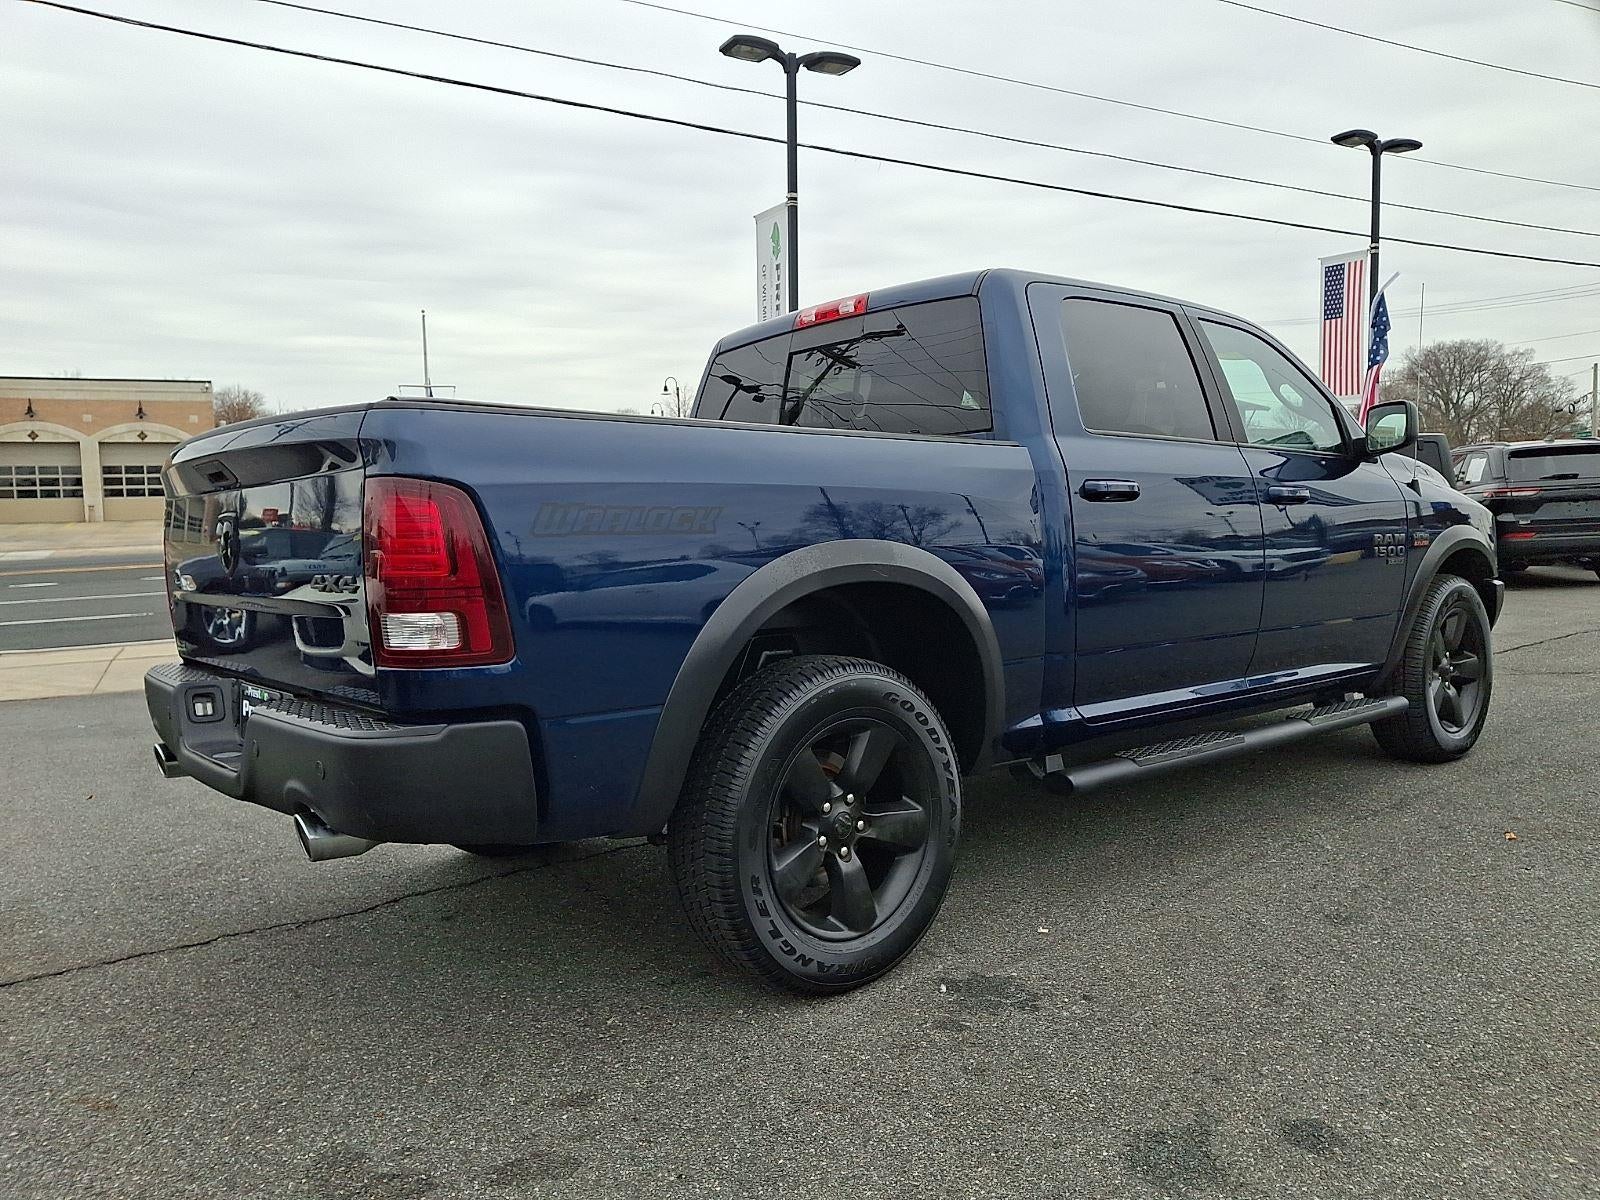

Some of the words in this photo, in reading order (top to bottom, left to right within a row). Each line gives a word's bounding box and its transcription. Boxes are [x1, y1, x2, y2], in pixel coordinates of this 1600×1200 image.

[531, 502, 724, 537] WARLOCK
[1374, 533, 1406, 545] RAM
[1373, 545, 1406, 557] 1500
[883, 692, 959, 848] GOODYEAR
